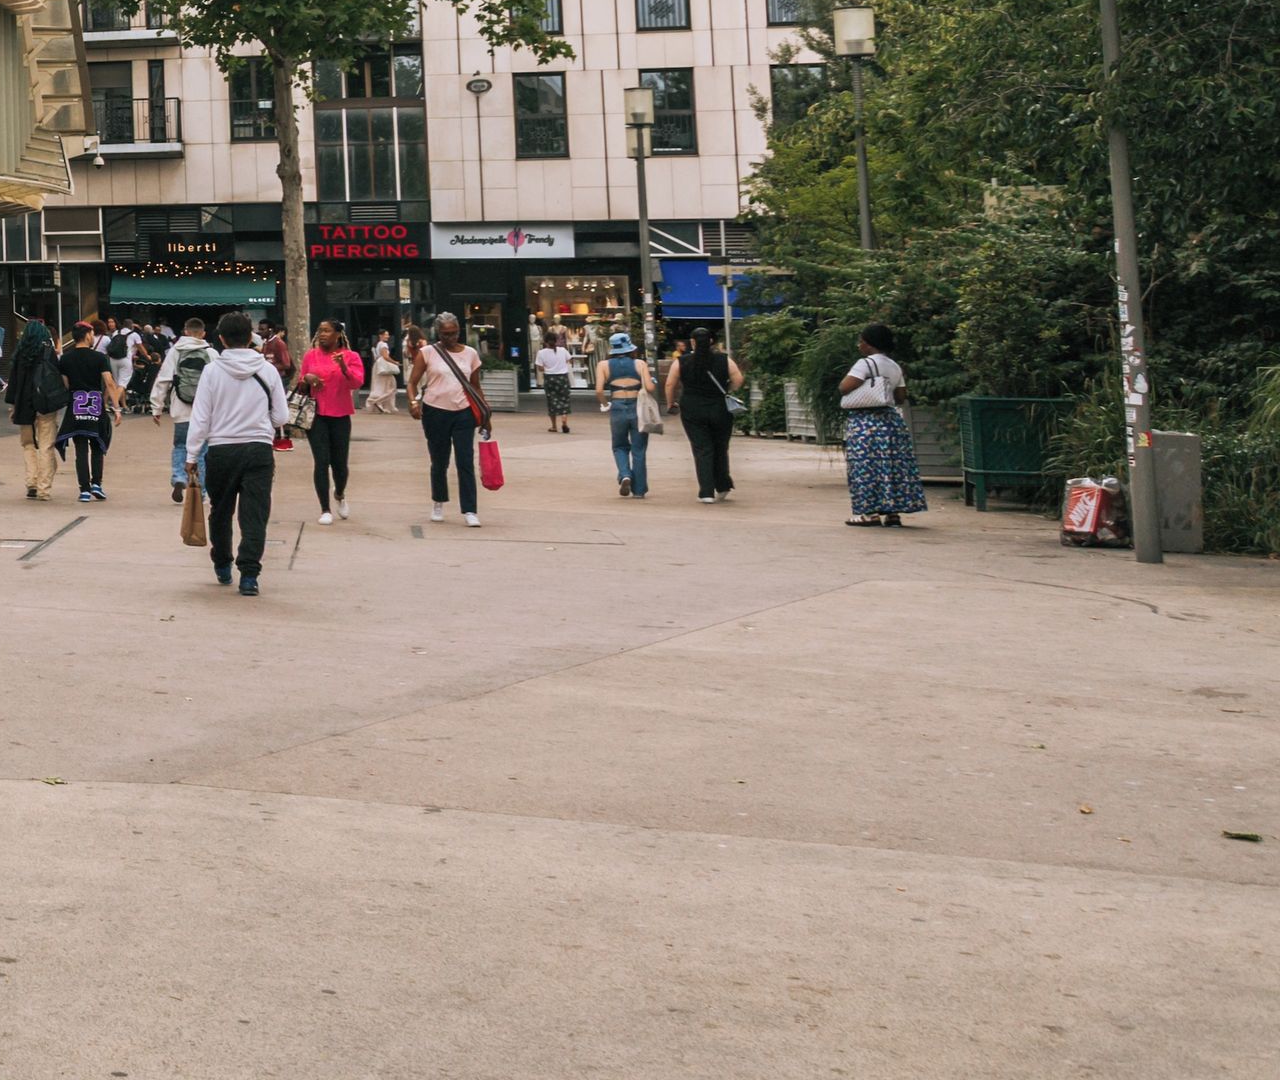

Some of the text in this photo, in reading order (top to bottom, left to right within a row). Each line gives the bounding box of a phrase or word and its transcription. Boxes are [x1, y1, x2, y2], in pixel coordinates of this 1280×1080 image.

[319, 225, 408, 240] TATTOO
[524, 233, 555, 247] Trendy
[167, 242, 217, 253] liberti
[310, 244, 419, 258] PIERCING
[73, 390, 102, 416] 23
[1069, 493, 1091, 527] NIKE
